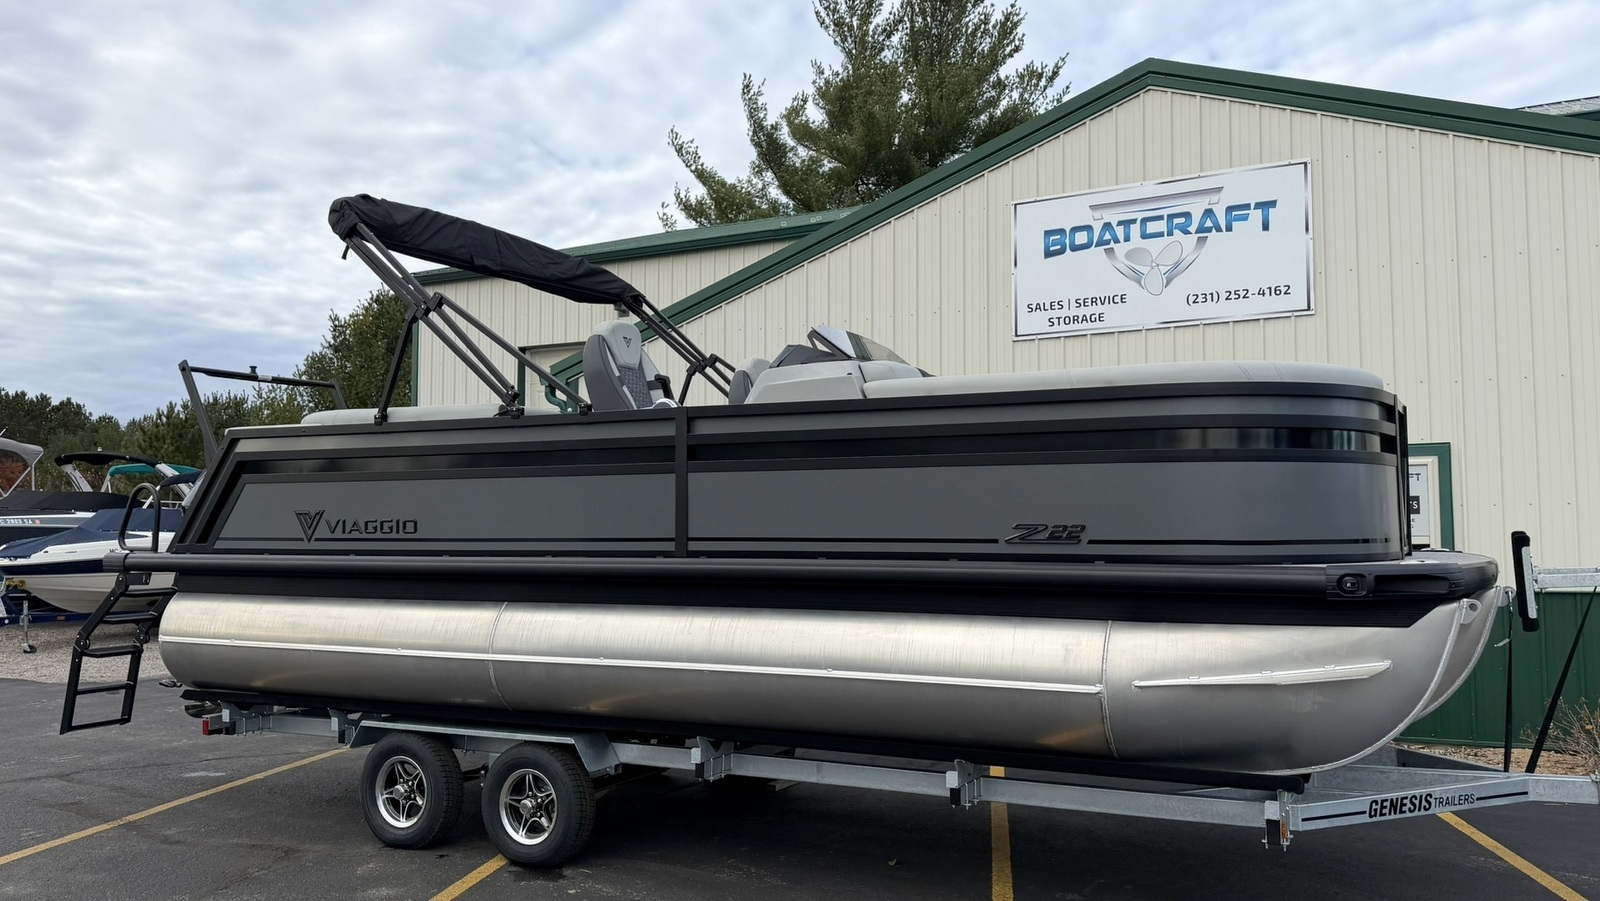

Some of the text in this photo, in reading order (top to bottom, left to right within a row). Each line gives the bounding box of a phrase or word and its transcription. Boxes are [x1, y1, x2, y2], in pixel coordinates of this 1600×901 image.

[1043, 199, 1278, 259] BOATCRAFT
[1027, 300, 1064, 313] SALES
[1075, 294, 1127, 308] SERVICE
[1186, 285, 1291, 306] (231) 252-4162
[1048, 312, 1105, 327] STORAGE
[325, 519, 418, 534] VIAGGIO
[1004, 523, 1086, 544] Z22
[1368, 793, 1475, 818] GENESIS TRAILERS
